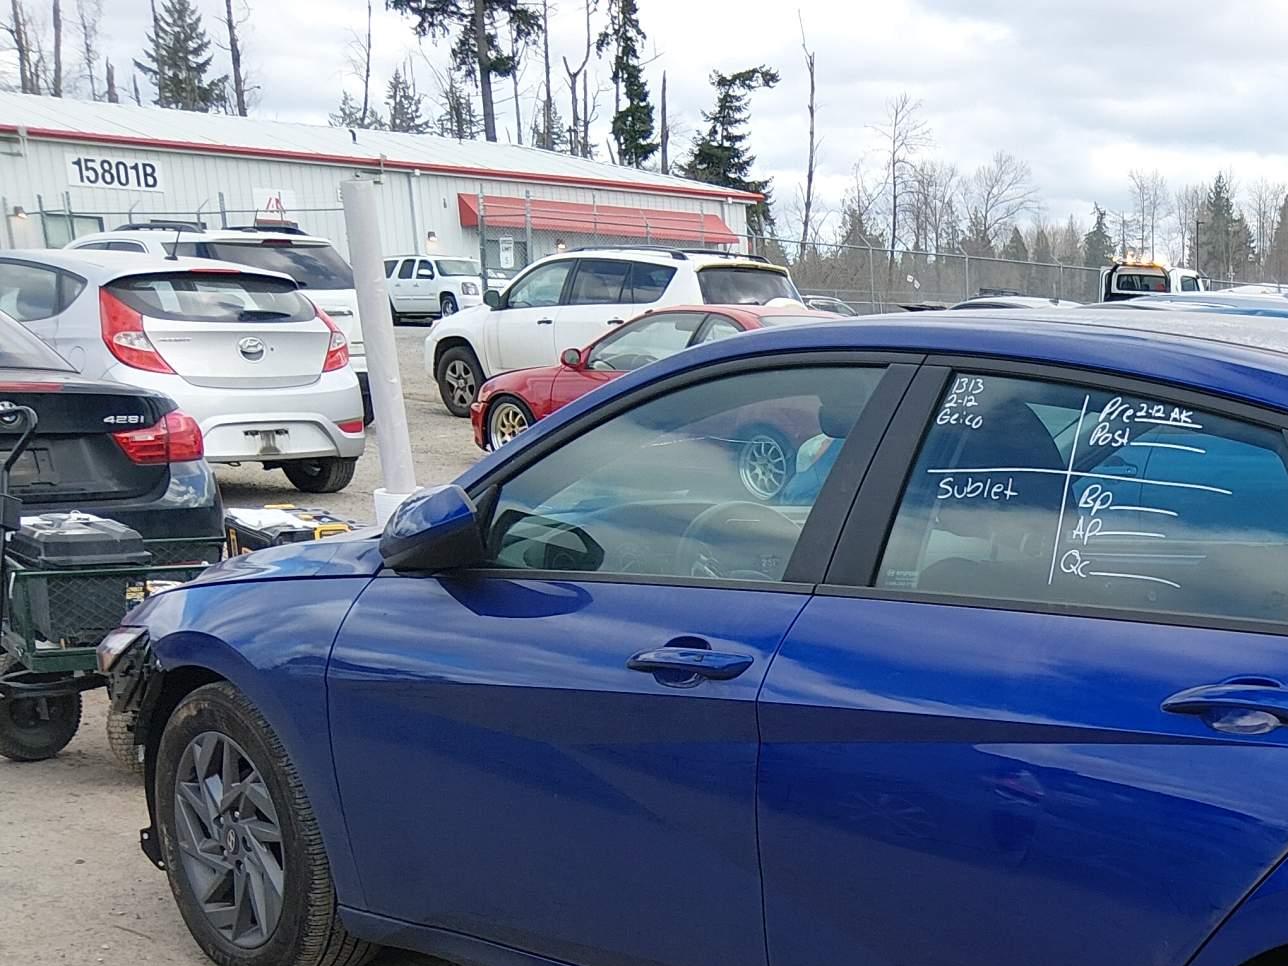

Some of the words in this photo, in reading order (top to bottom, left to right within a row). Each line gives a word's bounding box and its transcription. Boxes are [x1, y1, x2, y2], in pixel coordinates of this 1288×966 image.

[72, 157, 158, 188] 15801B
[952, 377, 984, 394] 1313
[945, 394, 979, 407] 2-12
[1099, 397, 1134, 422] Pre
[1170, 407, 1193, 424] AK
[936, 408, 983, 429] Geico
[1089, 422, 1130, 447] Post
[937, 477, 1019, 500] Sublet
